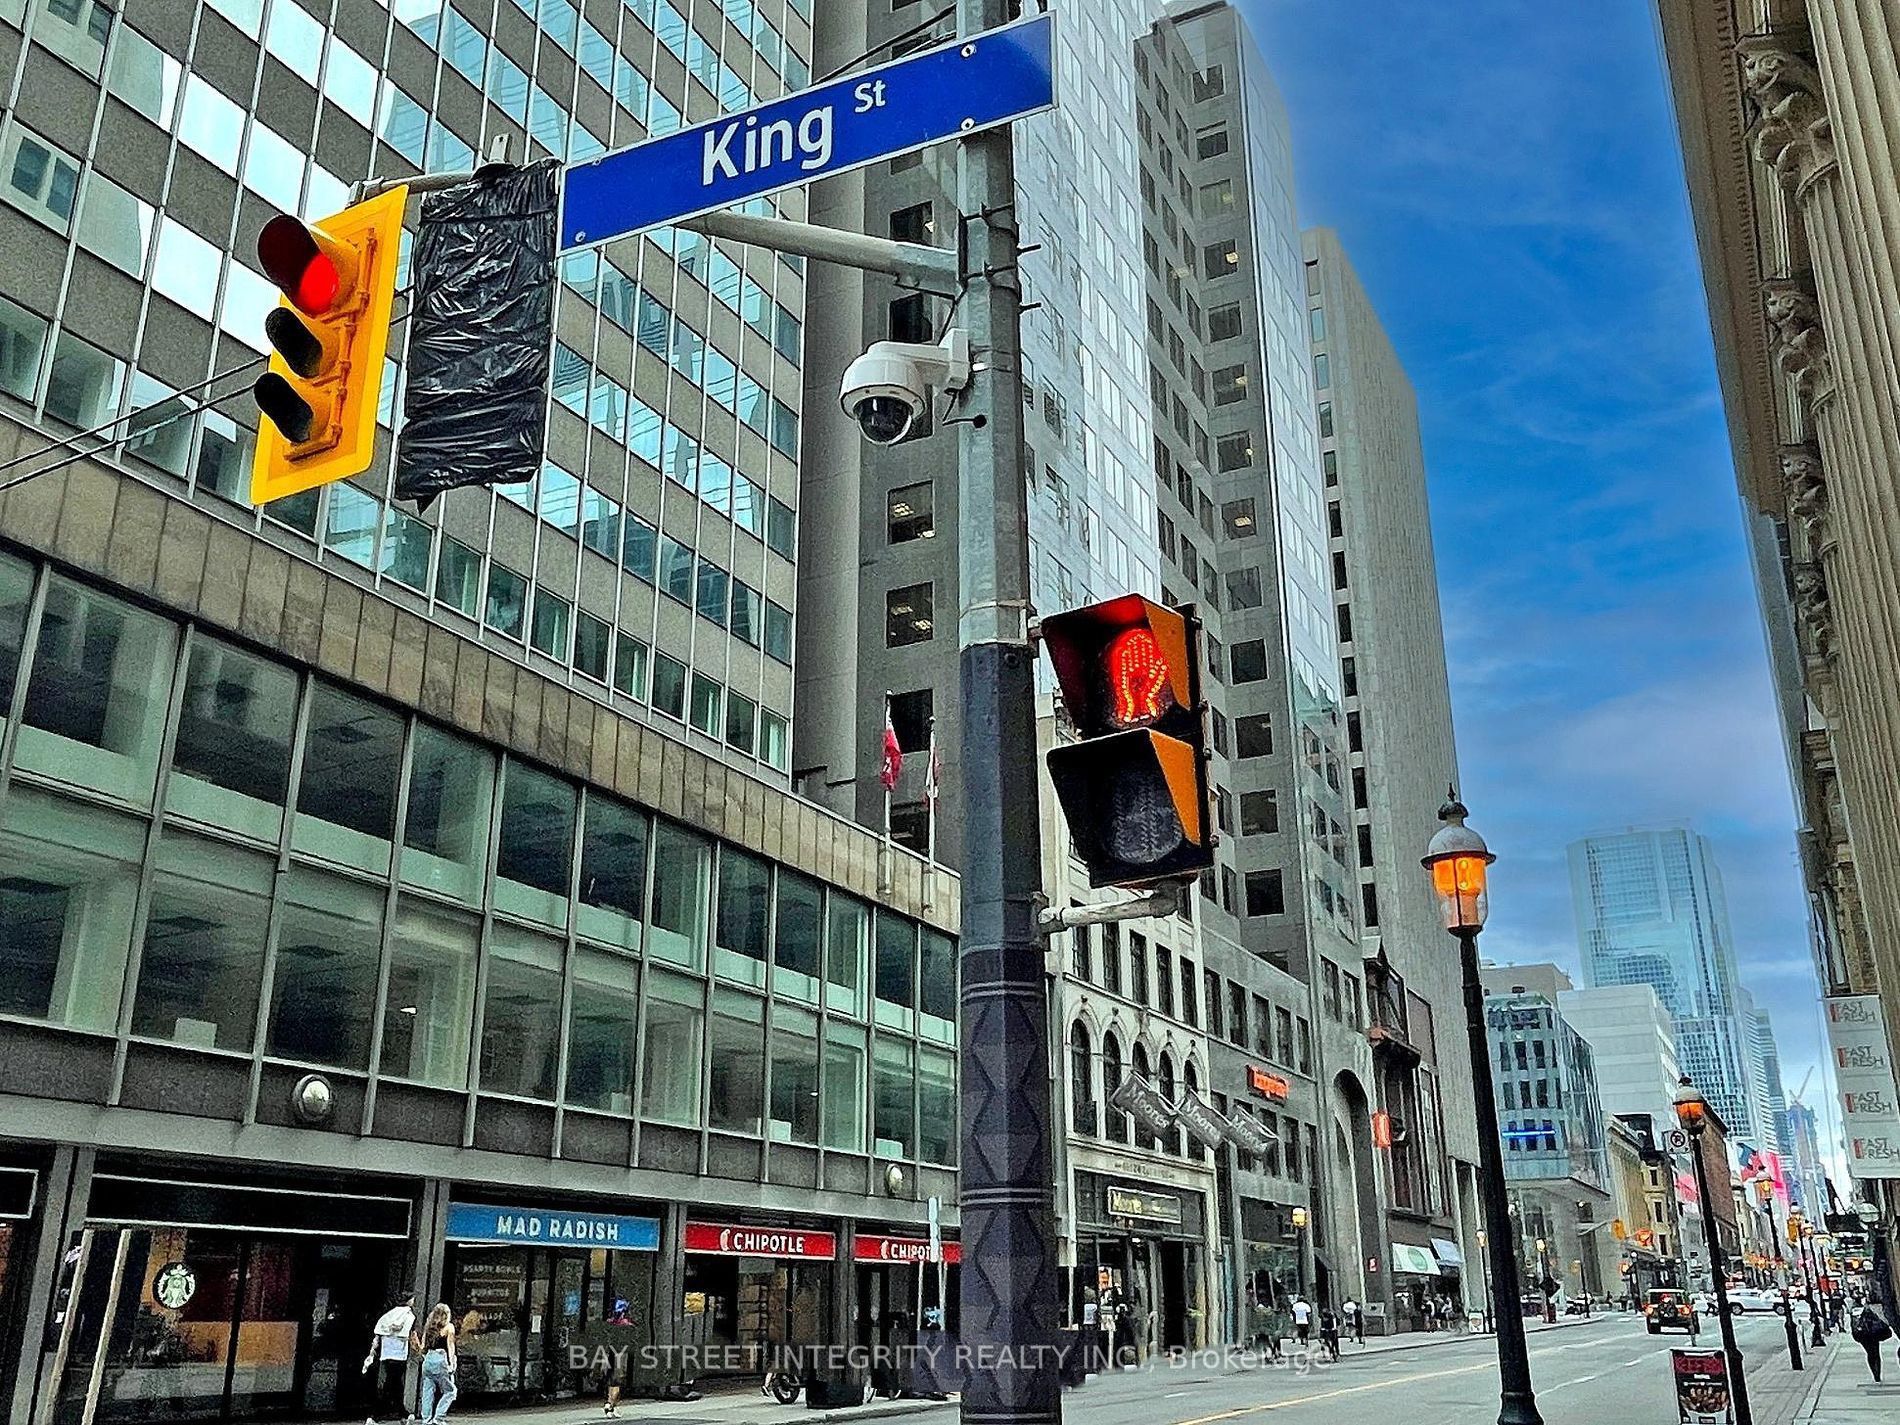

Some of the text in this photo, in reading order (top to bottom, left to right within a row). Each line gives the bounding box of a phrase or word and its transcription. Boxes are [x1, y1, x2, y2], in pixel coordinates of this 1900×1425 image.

[702, 80, 886, 186] King St
[1126, 1084, 1169, 1128] Moores
[497, 1215, 619, 1241] MAD RADISH
[733, 1232, 805, 1254] CHIPOTLE
[890, 1243, 943, 1261] CHIPOT
